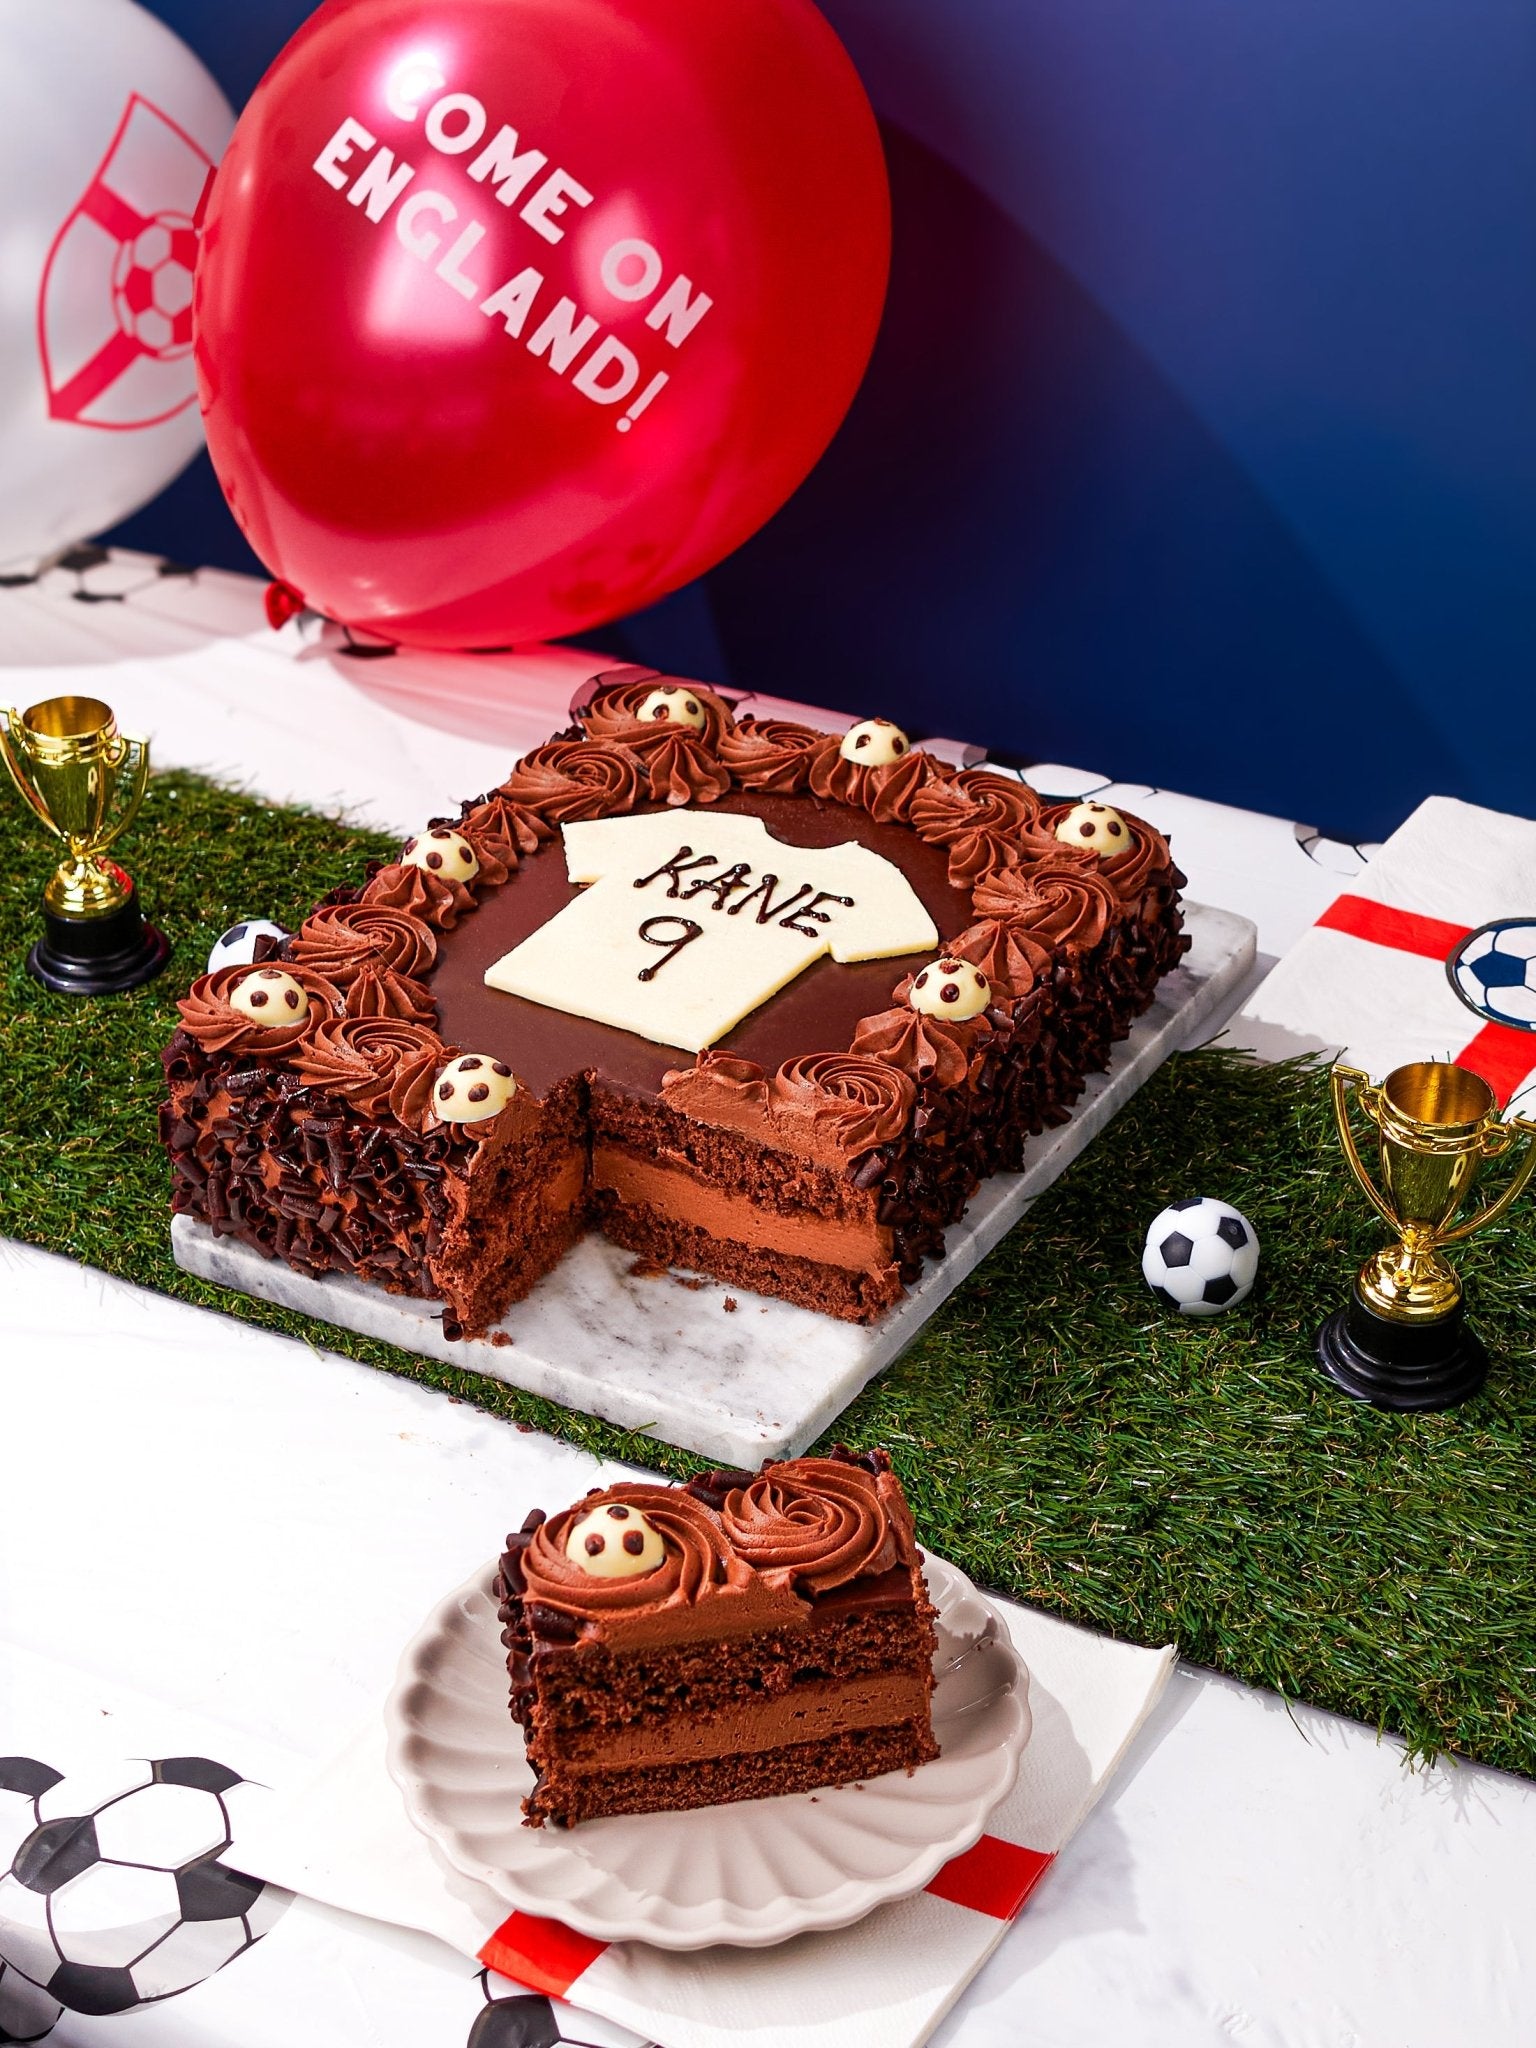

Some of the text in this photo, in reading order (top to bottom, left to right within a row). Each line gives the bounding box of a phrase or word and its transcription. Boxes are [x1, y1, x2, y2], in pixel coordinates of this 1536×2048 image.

[313, 116, 669, 432] ENGLAND!
[386, 52, 713, 349] COME ON
[633, 846, 854, 937] KANE
[638, 915, 703, 982] 9
